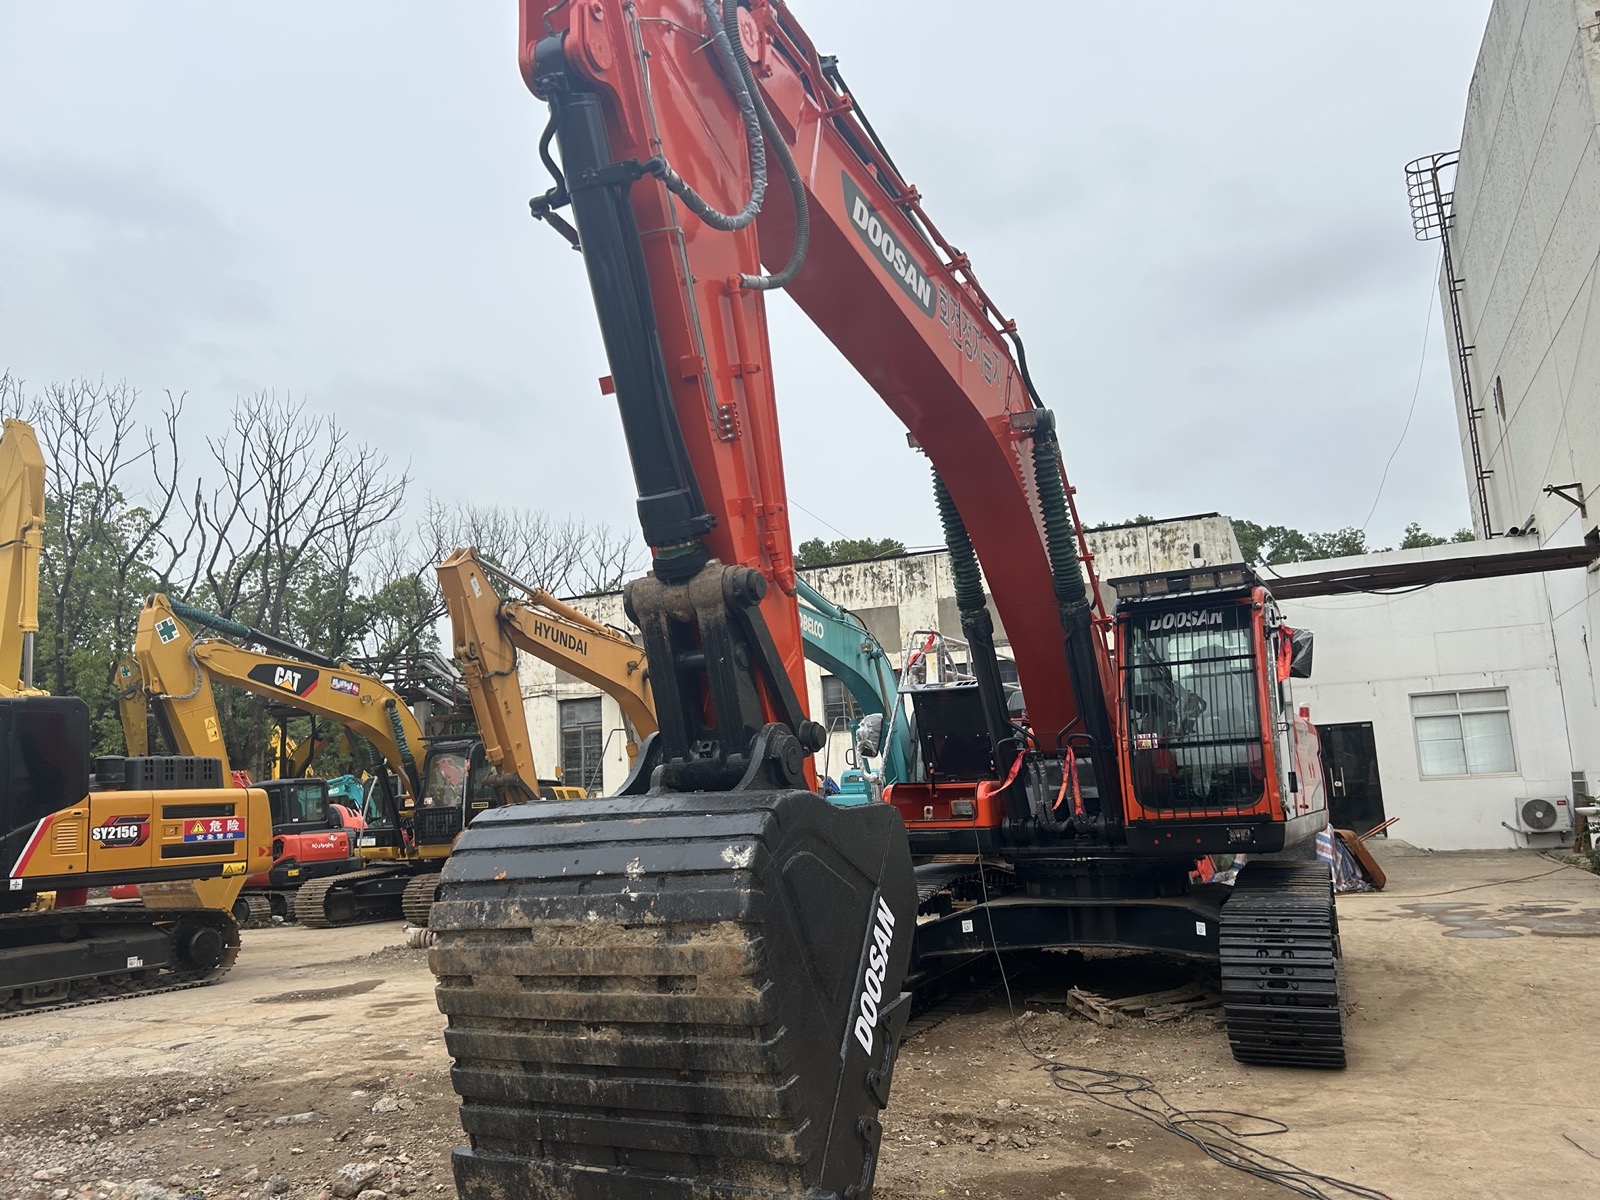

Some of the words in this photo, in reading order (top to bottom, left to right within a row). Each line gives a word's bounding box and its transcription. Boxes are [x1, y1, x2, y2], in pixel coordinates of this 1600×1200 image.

[852, 195, 932, 308] DOOSAN
[1149, 609, 1223, 631] DOOSAN
[534, 619, 588, 656] HYUNDAI
[274, 666, 301, 692] CAT
[92, 826, 138, 840] SY215C
[854, 895, 896, 1057] DOOSAN
